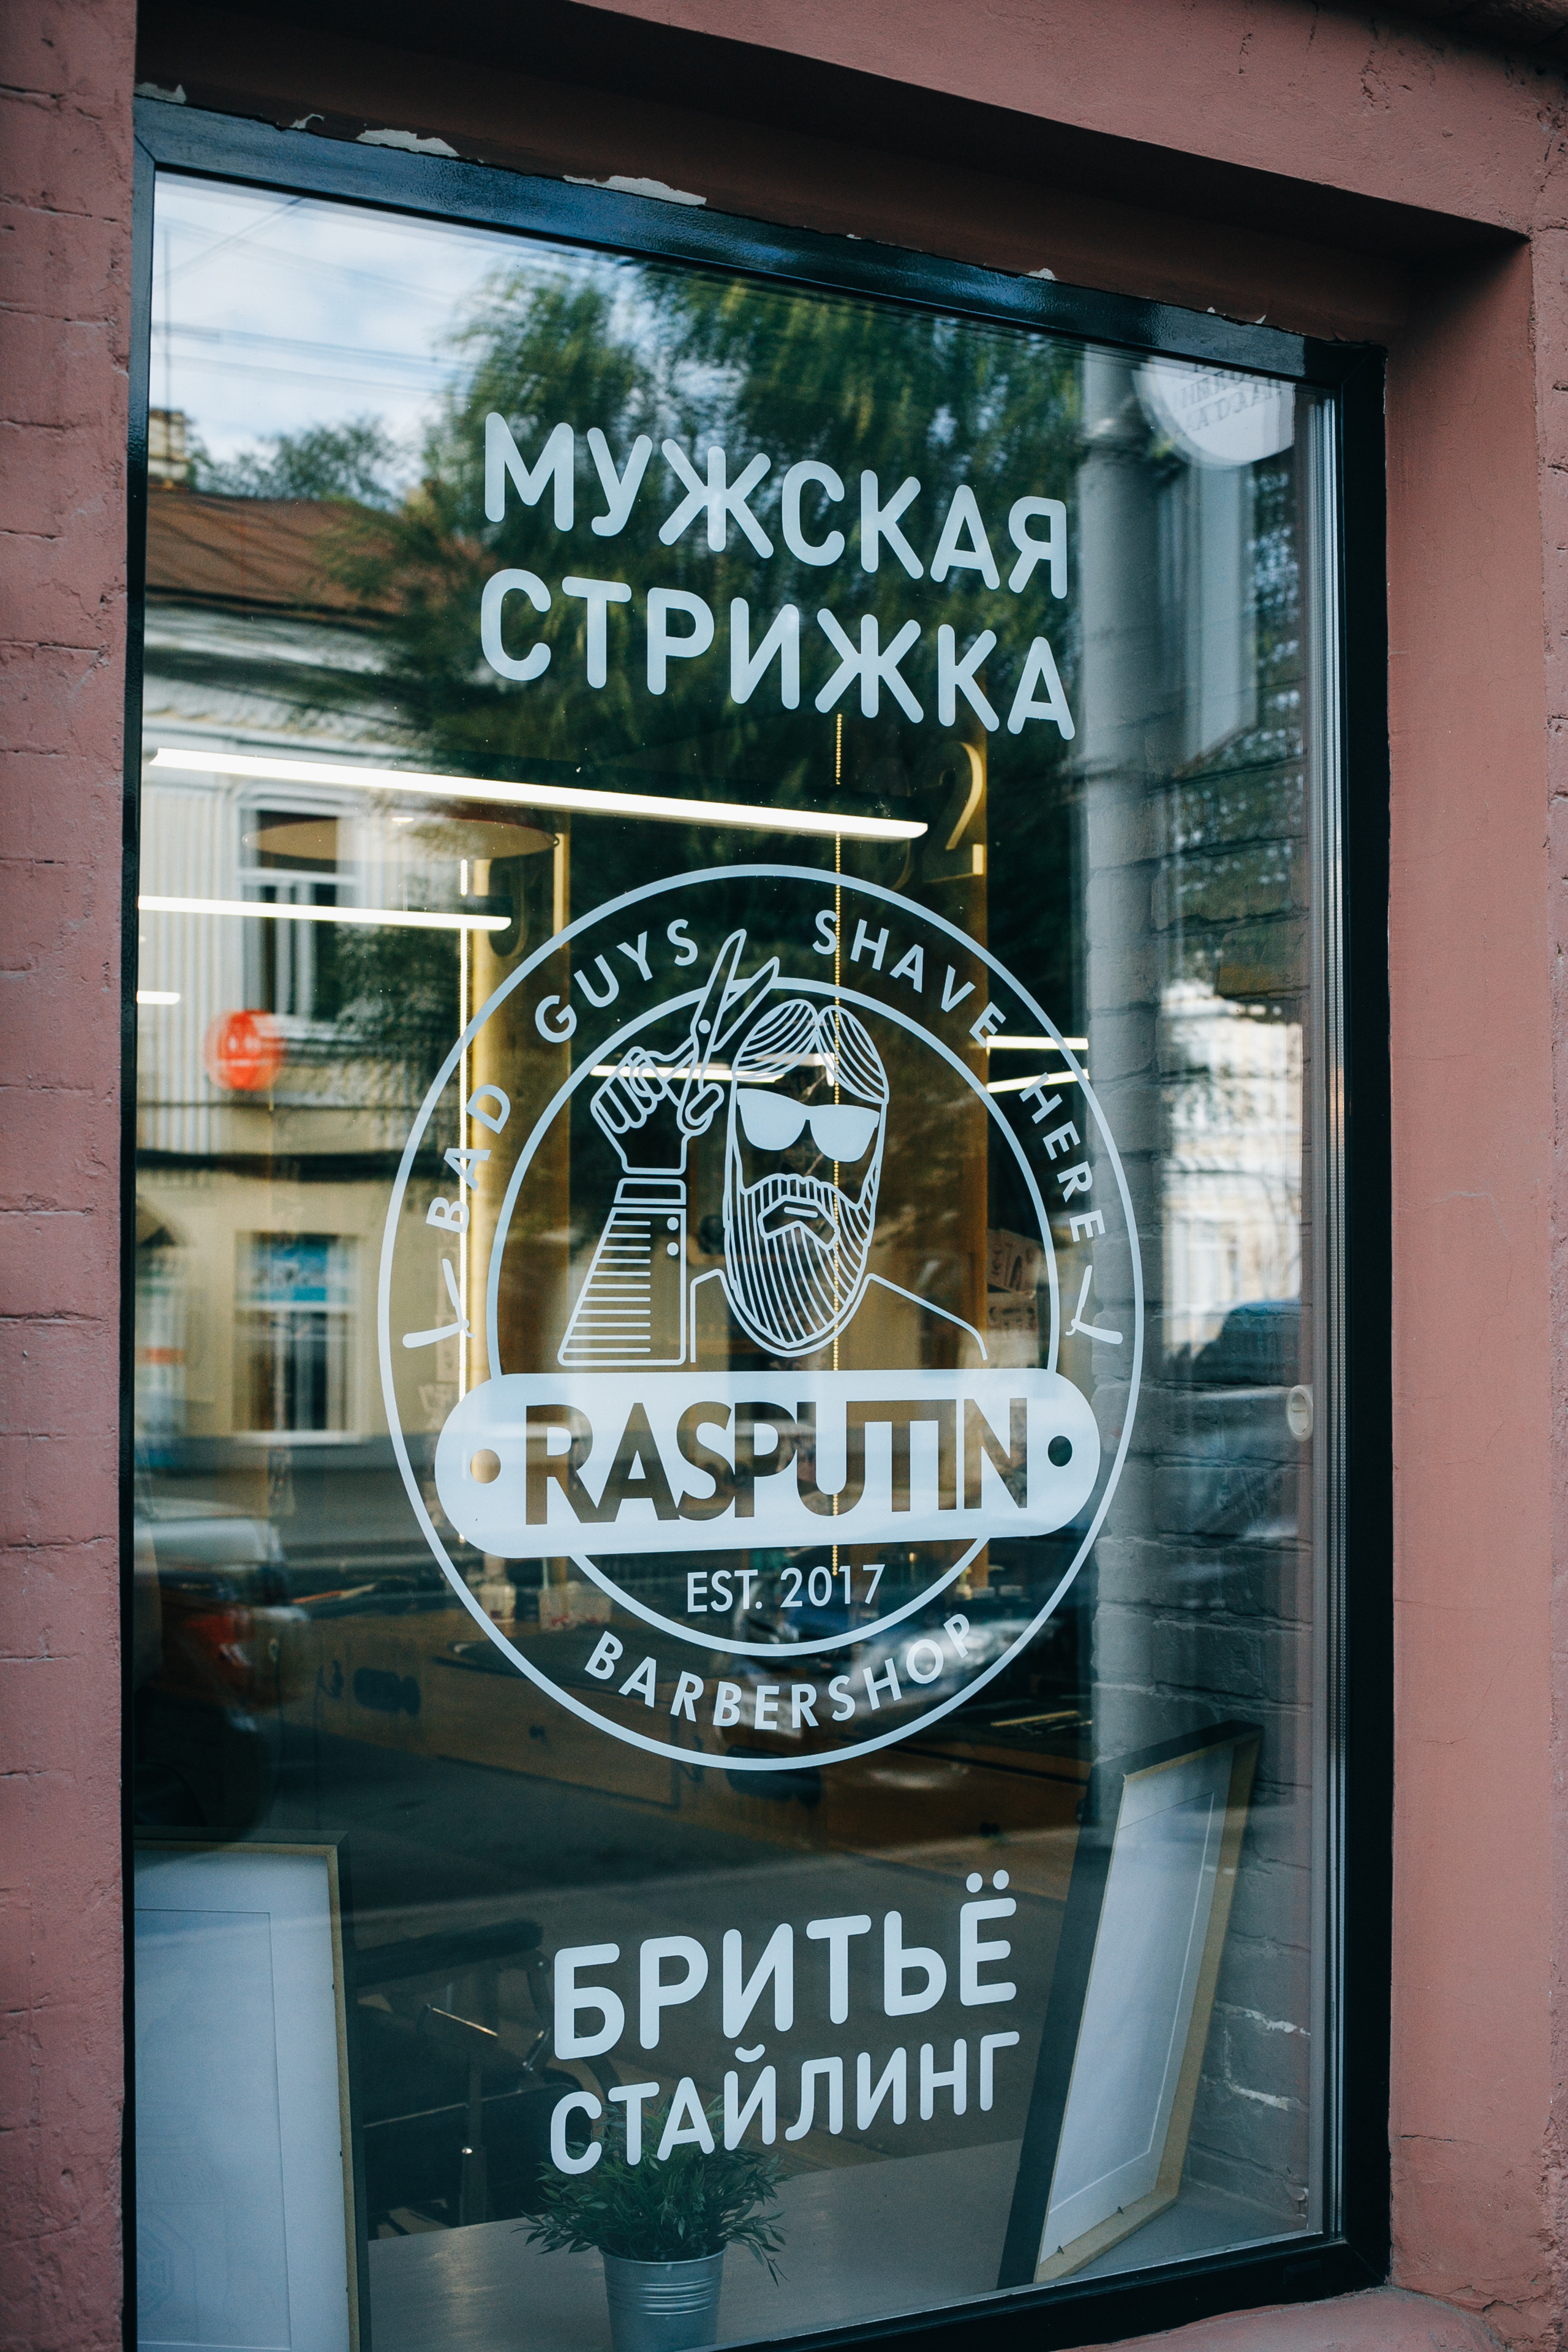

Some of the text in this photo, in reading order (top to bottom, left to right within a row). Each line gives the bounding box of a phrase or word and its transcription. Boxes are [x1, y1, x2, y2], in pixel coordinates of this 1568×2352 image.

[484, 412, 1068, 599] МУЖСКАЯ
[481, 567, 1076, 741] СТРИЖКА
[425, 909, 1106, 1243] BAD GUYS SHAVE HERE
[525, 1397, 1028, 1526] RASPUTIN
[686, 1563, 886, 1613] EST. 2017
[583, 1611, 973, 1732] BARBERSHOP
[553, 1869, 1017, 2061] БРИТЬЁ
[550, 2030, 1021, 2176] СТАЙЛИНГ
